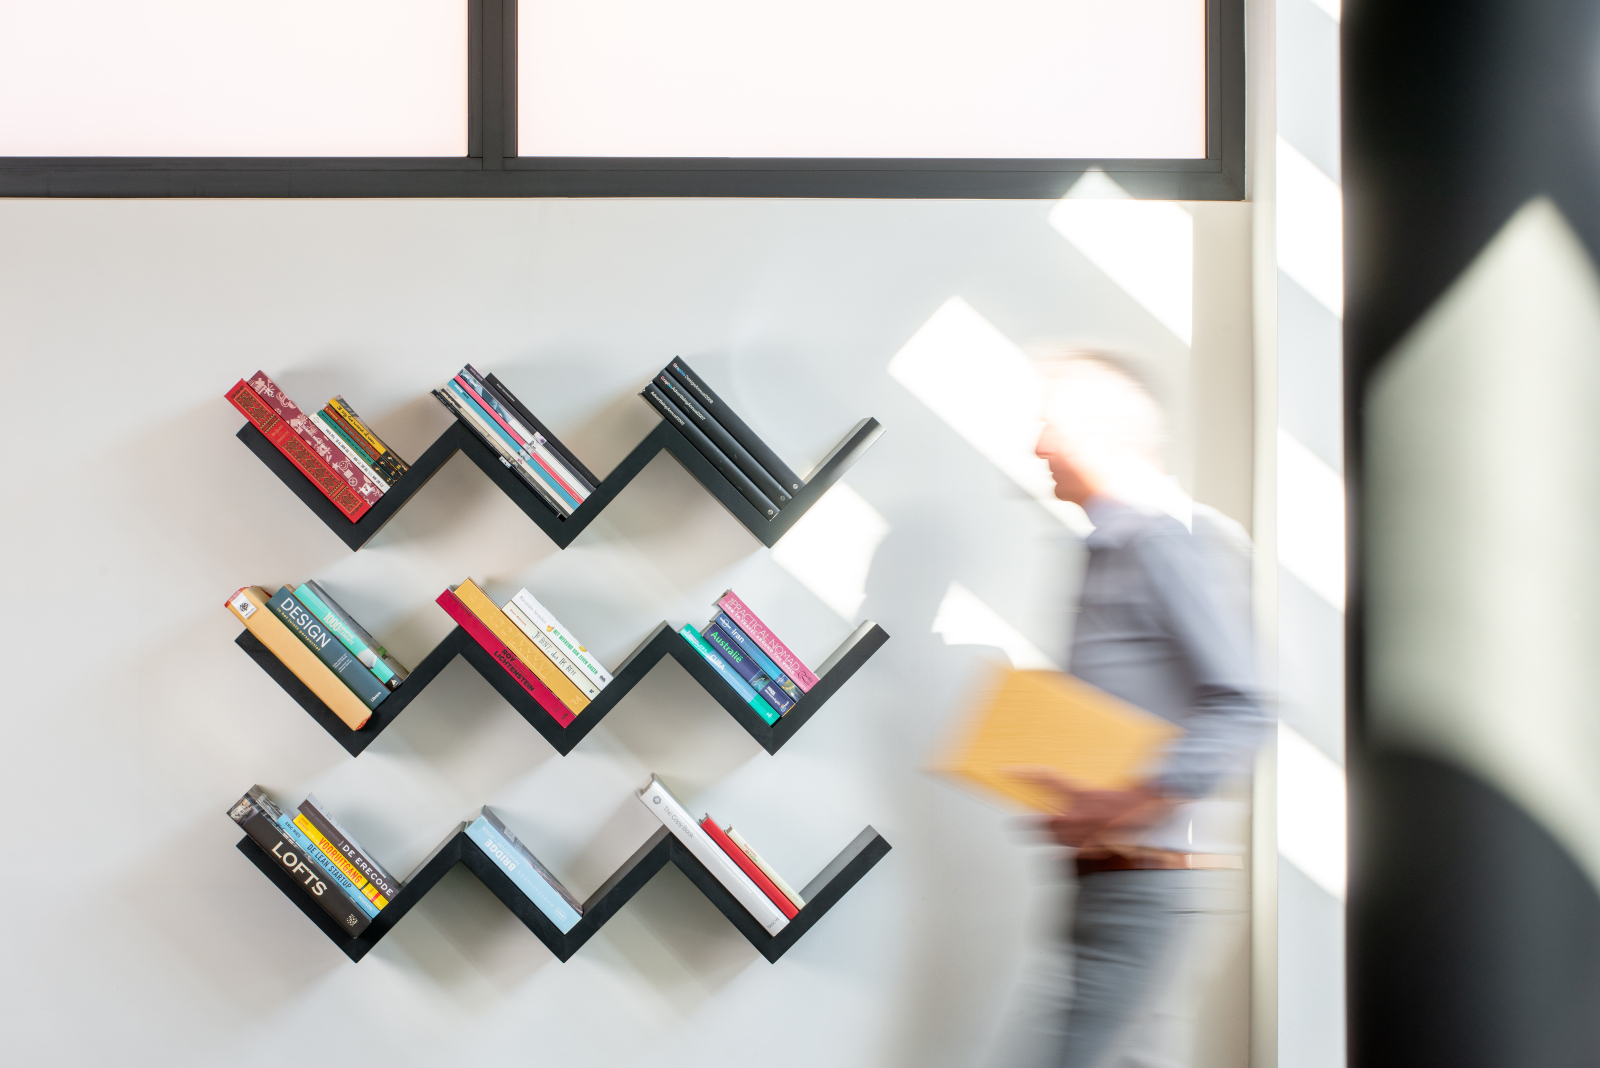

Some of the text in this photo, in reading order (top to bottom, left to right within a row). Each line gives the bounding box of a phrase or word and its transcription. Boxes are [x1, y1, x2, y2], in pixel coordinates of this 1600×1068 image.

[279, 597, 331, 648] DESIGN
[281, 611, 289, 619] het
[322, 611, 342, 632] 1000
[337, 628, 354, 645] ELEMENTS
[340, 625, 355, 640] GRAPHIC
[518, 595, 534, 611] Ricardo
[552, 628, 560, 637] HET
[558, 634, 574, 650] WEEKEND
[571, 647, 580, 656] VAN
[577, 654, 588, 665] ZEVEN
[586, 663, 598, 675] DAGEN
[710, 629, 744, 663] Australië
[723, 603, 735, 614] HOW
[739, 619, 755, 635] TRAVEL
[755, 634, 773, 653] AROUND
[772, 652, 782, 661] THE
[781, 661, 795, 674] WORLD
[729, 599, 771, 641] PRACTICAL
[767, 638, 801, 672] NOMAD
[730, 627, 746, 643] Iran
[493, 650, 535, 691] LICHTENSTEIN
[501, 648, 515, 663] ROY
[708, 653, 726, 671] CUBA
[662, 805, 695, 839] The Copy Book
[270, 839, 328, 898] LOFTS
[284, 821, 353, 890] ERIC RIES DE LEAN STARTUP
[316, 837, 363, 884] VOORUITGANG
[341, 844, 394, 896] DE ERECODE
[483, 838, 516, 871] BRIDGE
[356, 895, 373, 911] PEARSON
